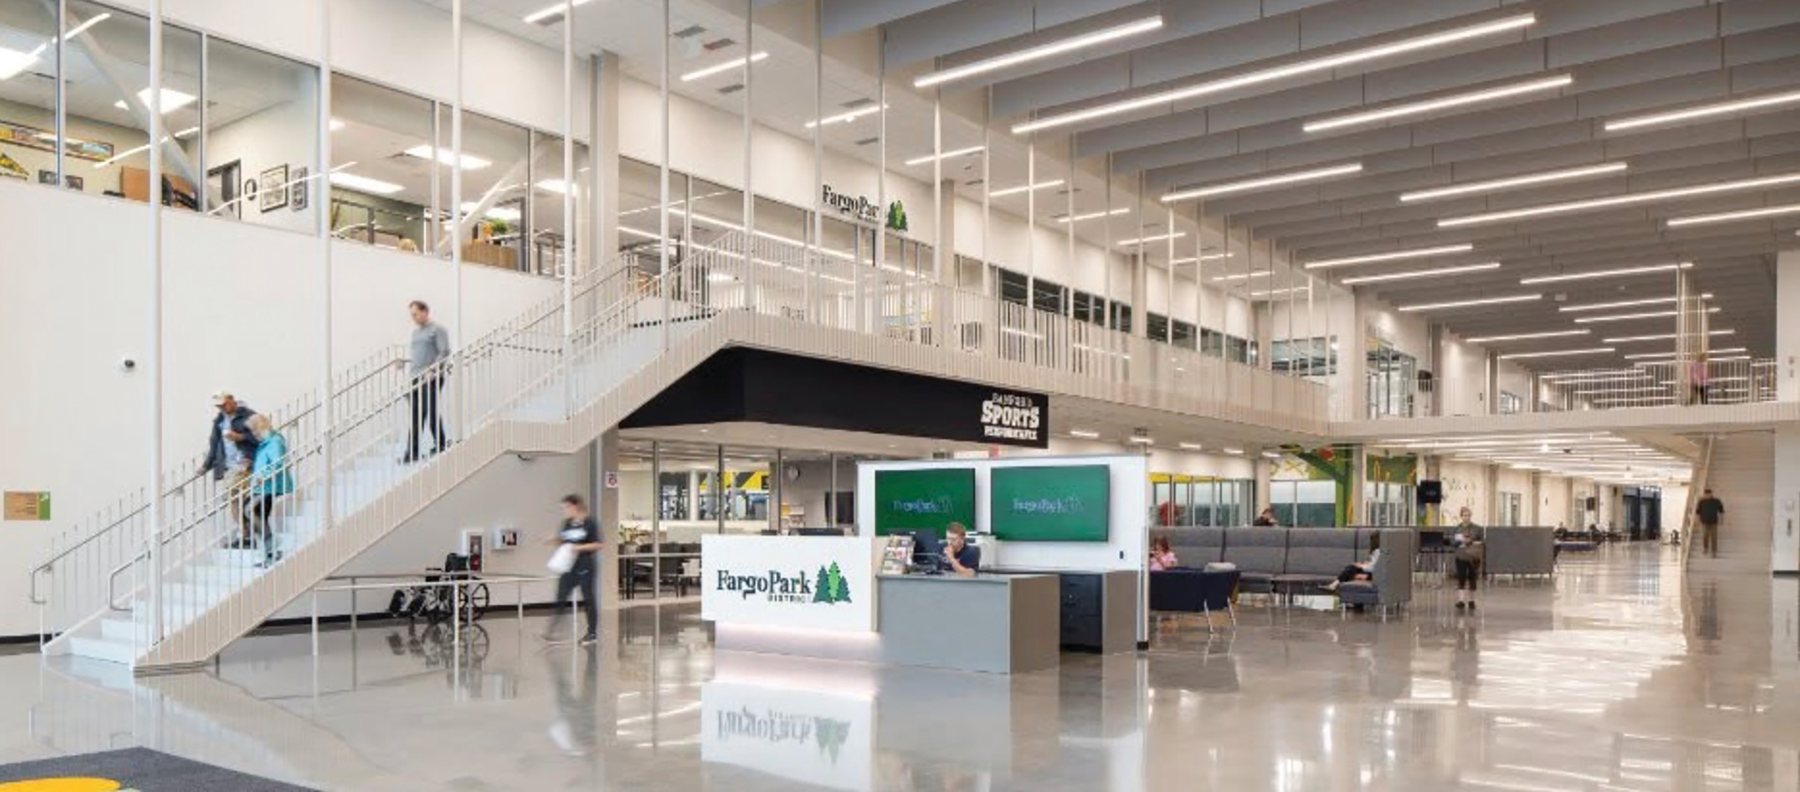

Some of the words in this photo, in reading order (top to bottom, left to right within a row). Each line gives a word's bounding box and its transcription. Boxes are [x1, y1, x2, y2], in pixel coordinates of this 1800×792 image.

[822, 184, 881, 214] FargoPar
[980, 400, 1040, 429] SPORTS
[716, 569, 811, 600] FargoPark
